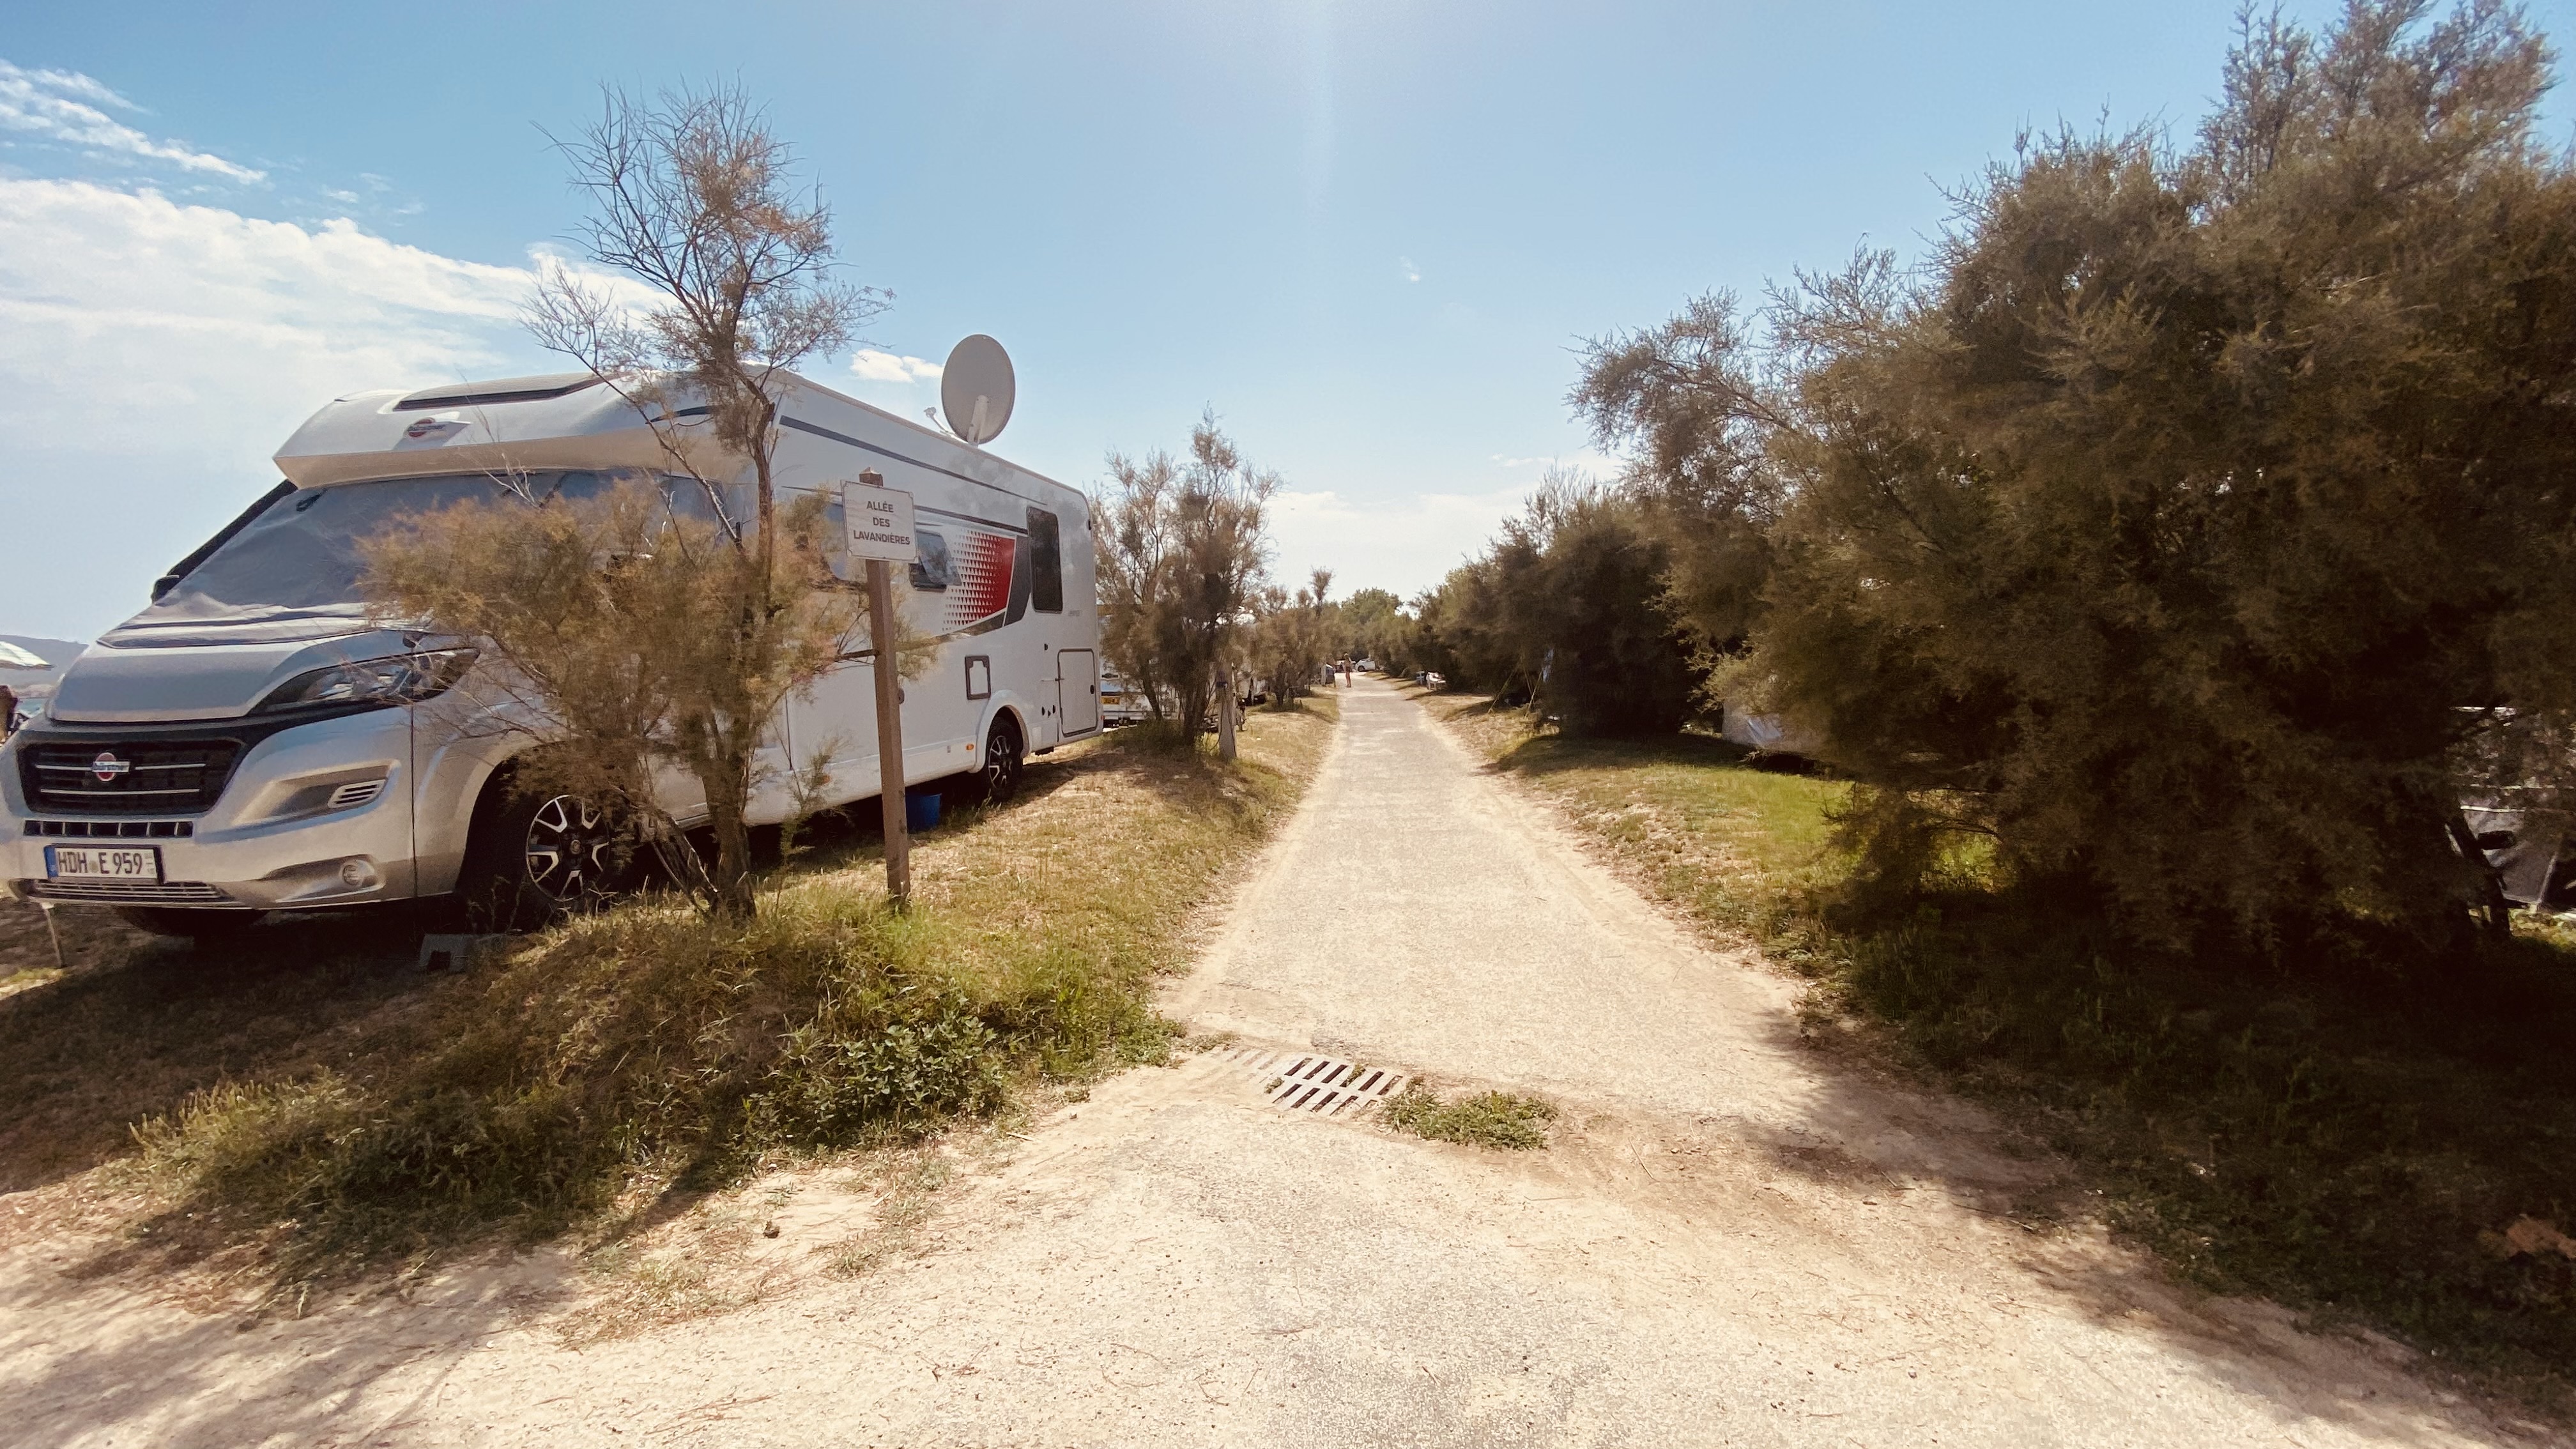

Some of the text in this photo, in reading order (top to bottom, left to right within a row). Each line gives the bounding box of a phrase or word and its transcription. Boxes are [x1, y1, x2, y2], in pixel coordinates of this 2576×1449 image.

[866, 501, 894, 512] ALLÉE
[873, 517, 890, 527] DES
[57, 851, 88, 873] HDH
[98, 852, 110, 874] E
[112, 852, 142, 874] 959
